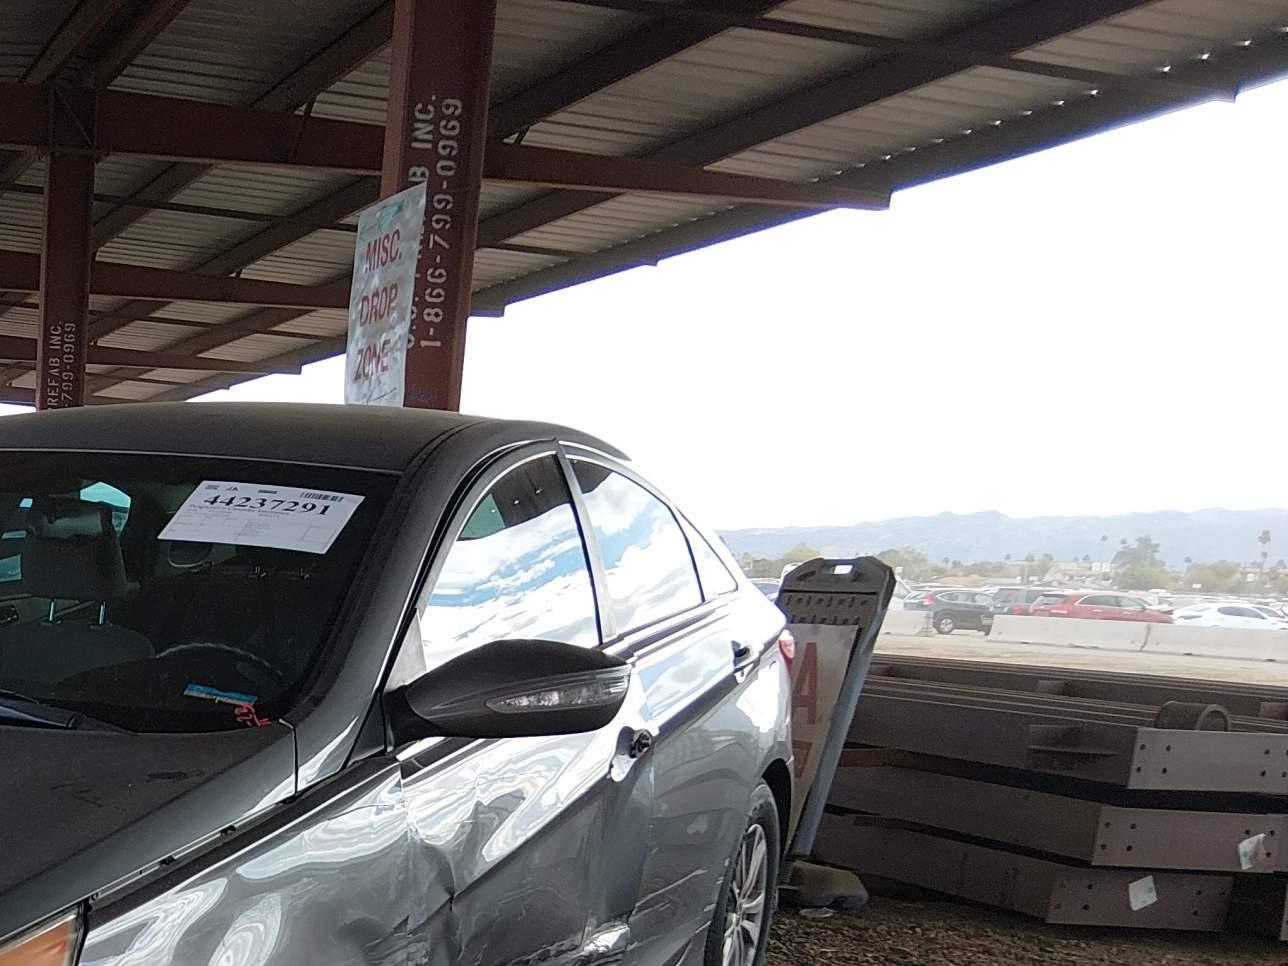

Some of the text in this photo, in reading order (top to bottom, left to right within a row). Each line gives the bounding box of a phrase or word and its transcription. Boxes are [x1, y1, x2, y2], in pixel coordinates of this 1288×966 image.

[412, 95, 437, 150] INC.
[420, 99, 462, 348] 1-866-799-0969
[364, 229, 403, 273] MISC.
[359, 283, 399, 328] DROP
[47, 321, 62, 411] REFAB INC.
[353, 339, 391, 384] ZONE
[203, 494, 331, 516] 44237291
